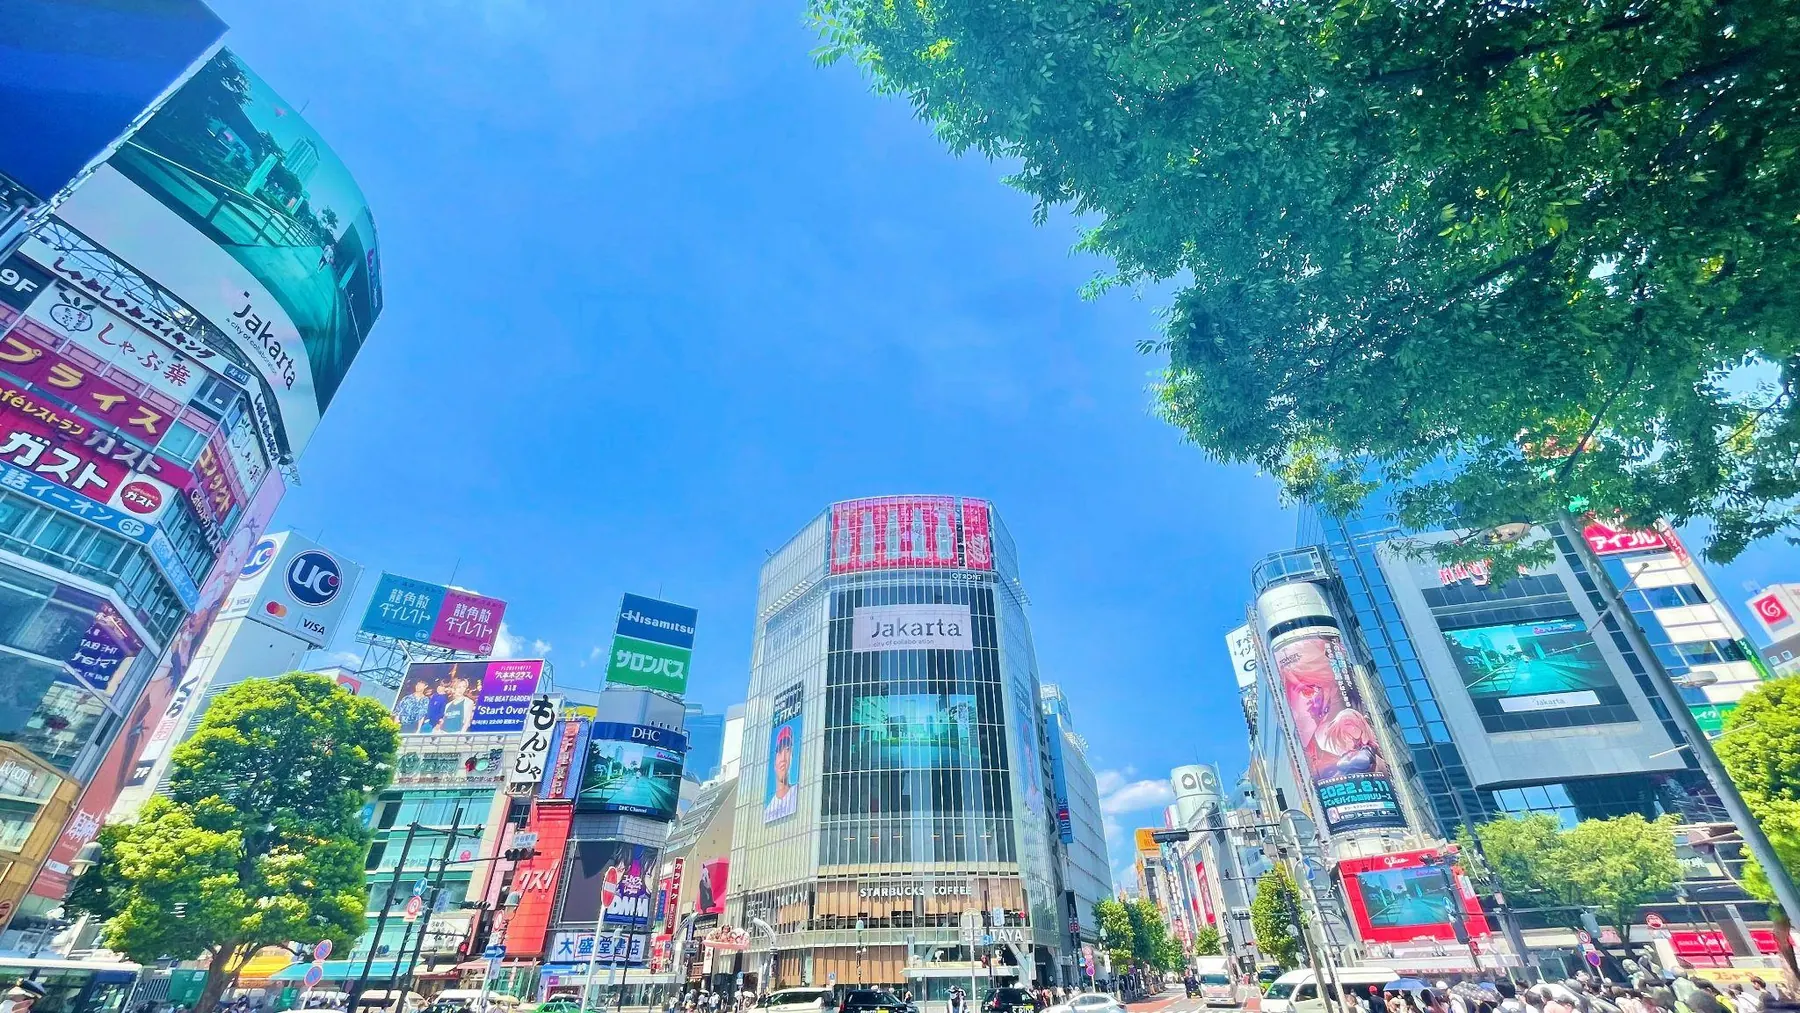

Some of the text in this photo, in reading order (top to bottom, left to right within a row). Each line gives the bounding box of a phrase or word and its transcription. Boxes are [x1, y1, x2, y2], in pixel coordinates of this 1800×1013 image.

[1, 268, 38, 295] 9F
[98, 323, 190, 386] しゃぶ葉
[0, 431, 108, 490] ガスト
[84, 429, 162, 474] ガスト
[121, 520, 141, 535] 6F
[292, 558, 339, 597] UC
[388, 588, 431, 608] 龍角散
[379, 602, 431, 625] ダイレクト
[453, 602, 492, 622] 龍角散
[303, 618, 325, 635] VISA
[445, 616, 493, 638] ダイレクト
[621, 610, 694, 635] Hisamitsu
[870, 615, 962, 638] Jakarta
[616, 650, 684, 679] サロンパス
[509, 695, 530, 703] GARDEN
[515, 695, 555, 779] もんじゃ
[632, 727, 660, 742] DHC
[134, 767, 151, 779] 7F
[1320, 780, 1389, 800] 2022.8.11
[619, 804, 629, 812] DHC
[1383, 855, 1409, 869] Glico
[671, 863, 682, 899] カラオケ
[860, 884, 972, 897] STARBUCKS COFFEE
[607, 899, 649, 918] DMM
[557, 938, 640, 956] 大盛堂書店
